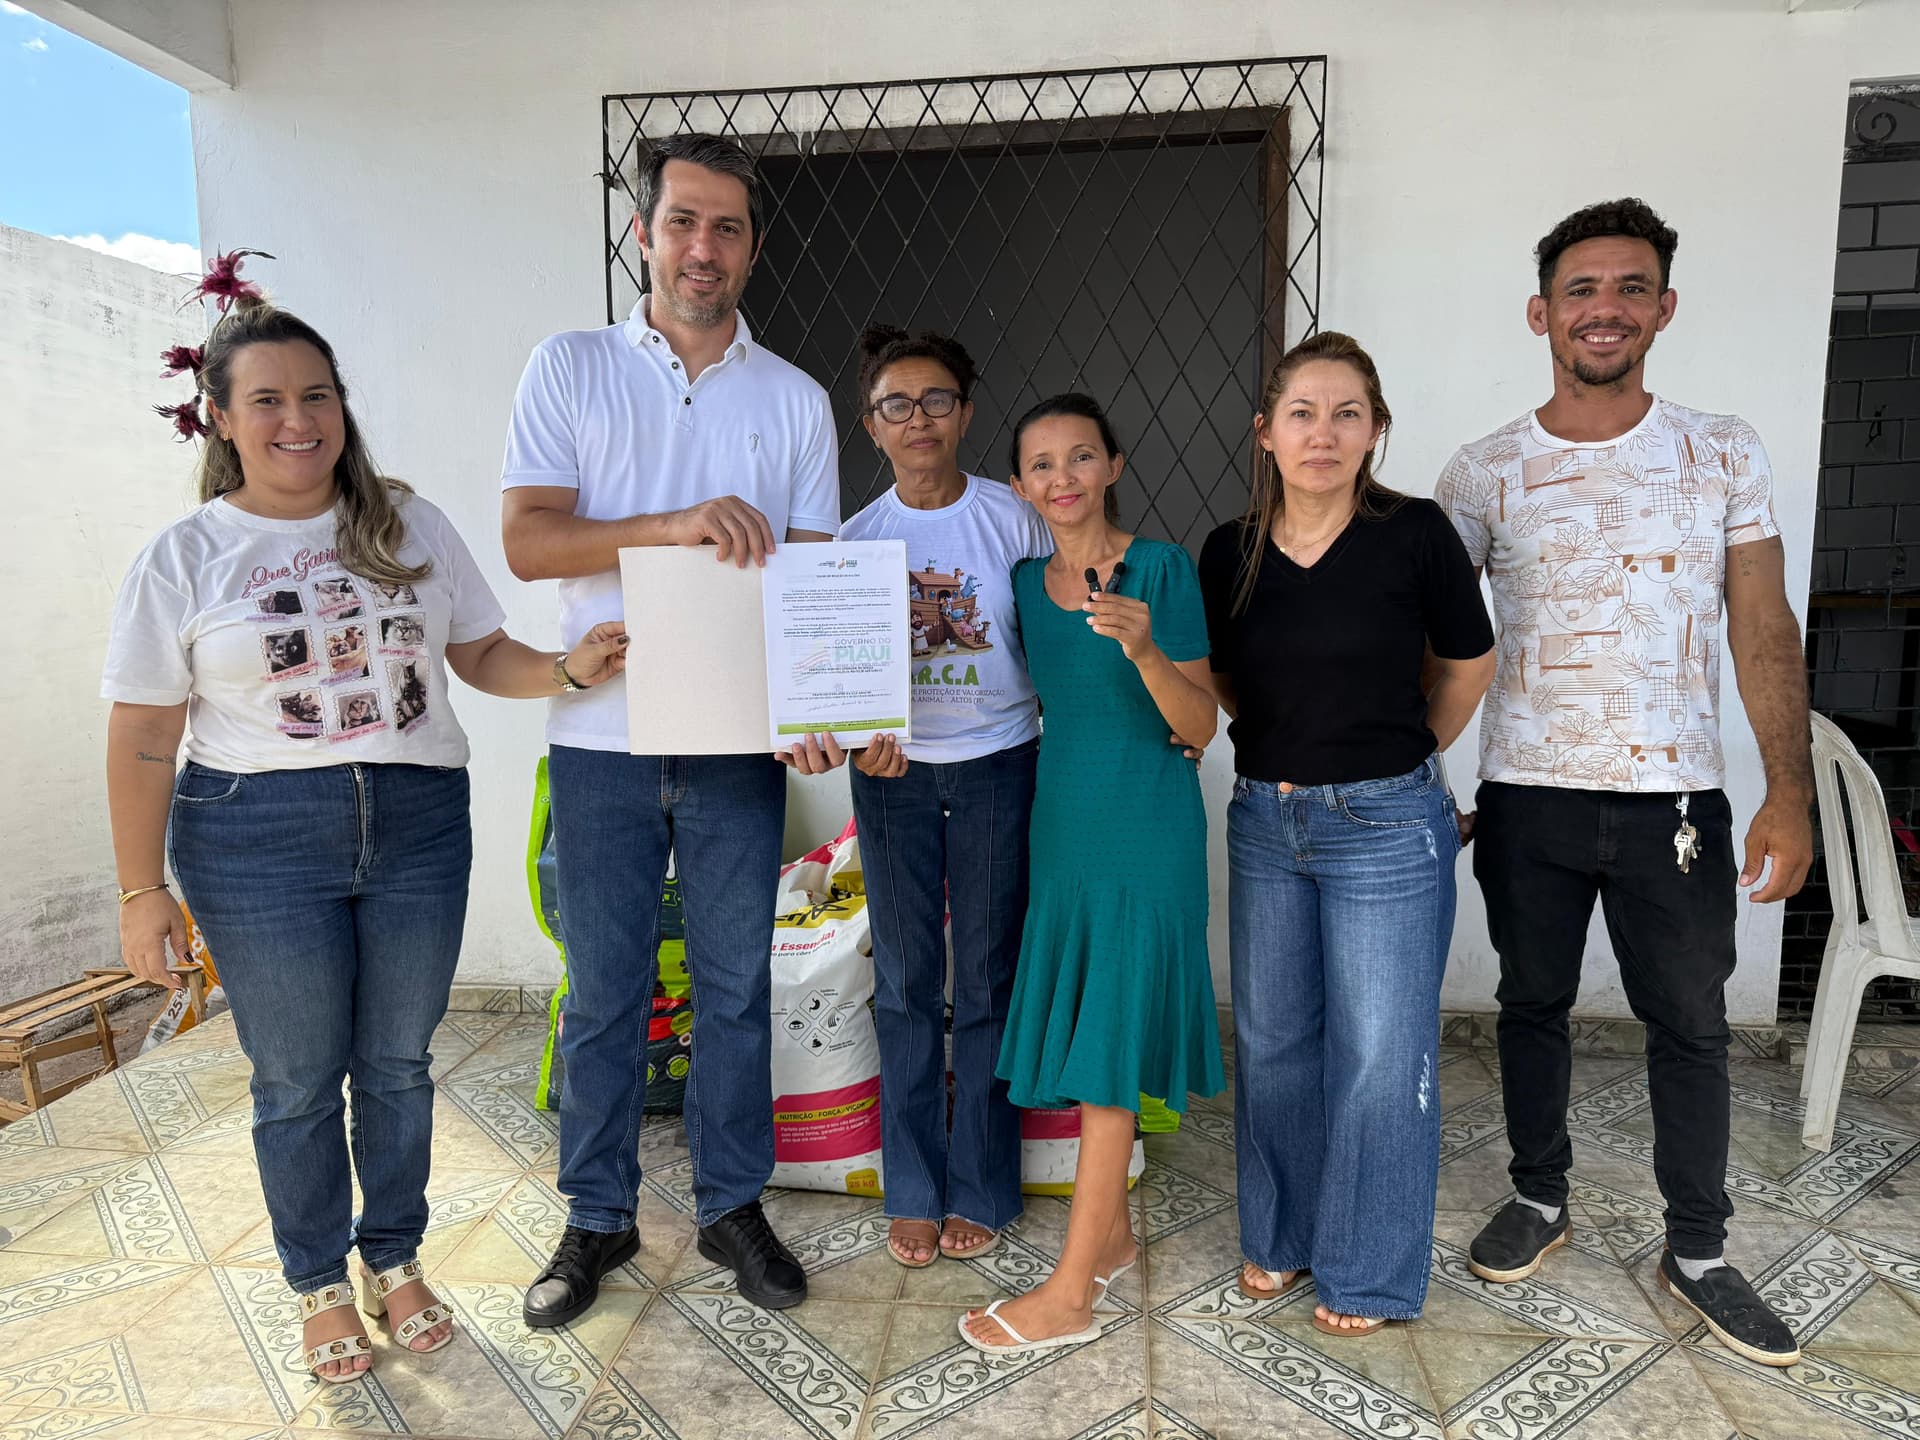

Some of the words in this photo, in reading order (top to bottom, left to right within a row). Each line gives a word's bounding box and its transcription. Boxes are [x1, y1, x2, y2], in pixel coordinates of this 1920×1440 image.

[834, 637, 876, 645] GOVERNO
[918, 688, 955, 696] PROTEÇÃO
[168, 999, 183, 1020] 25
[779, 1112, 813, 1120] NUTRIÇÃO
[818, 1109, 841, 1117] FORÇA
